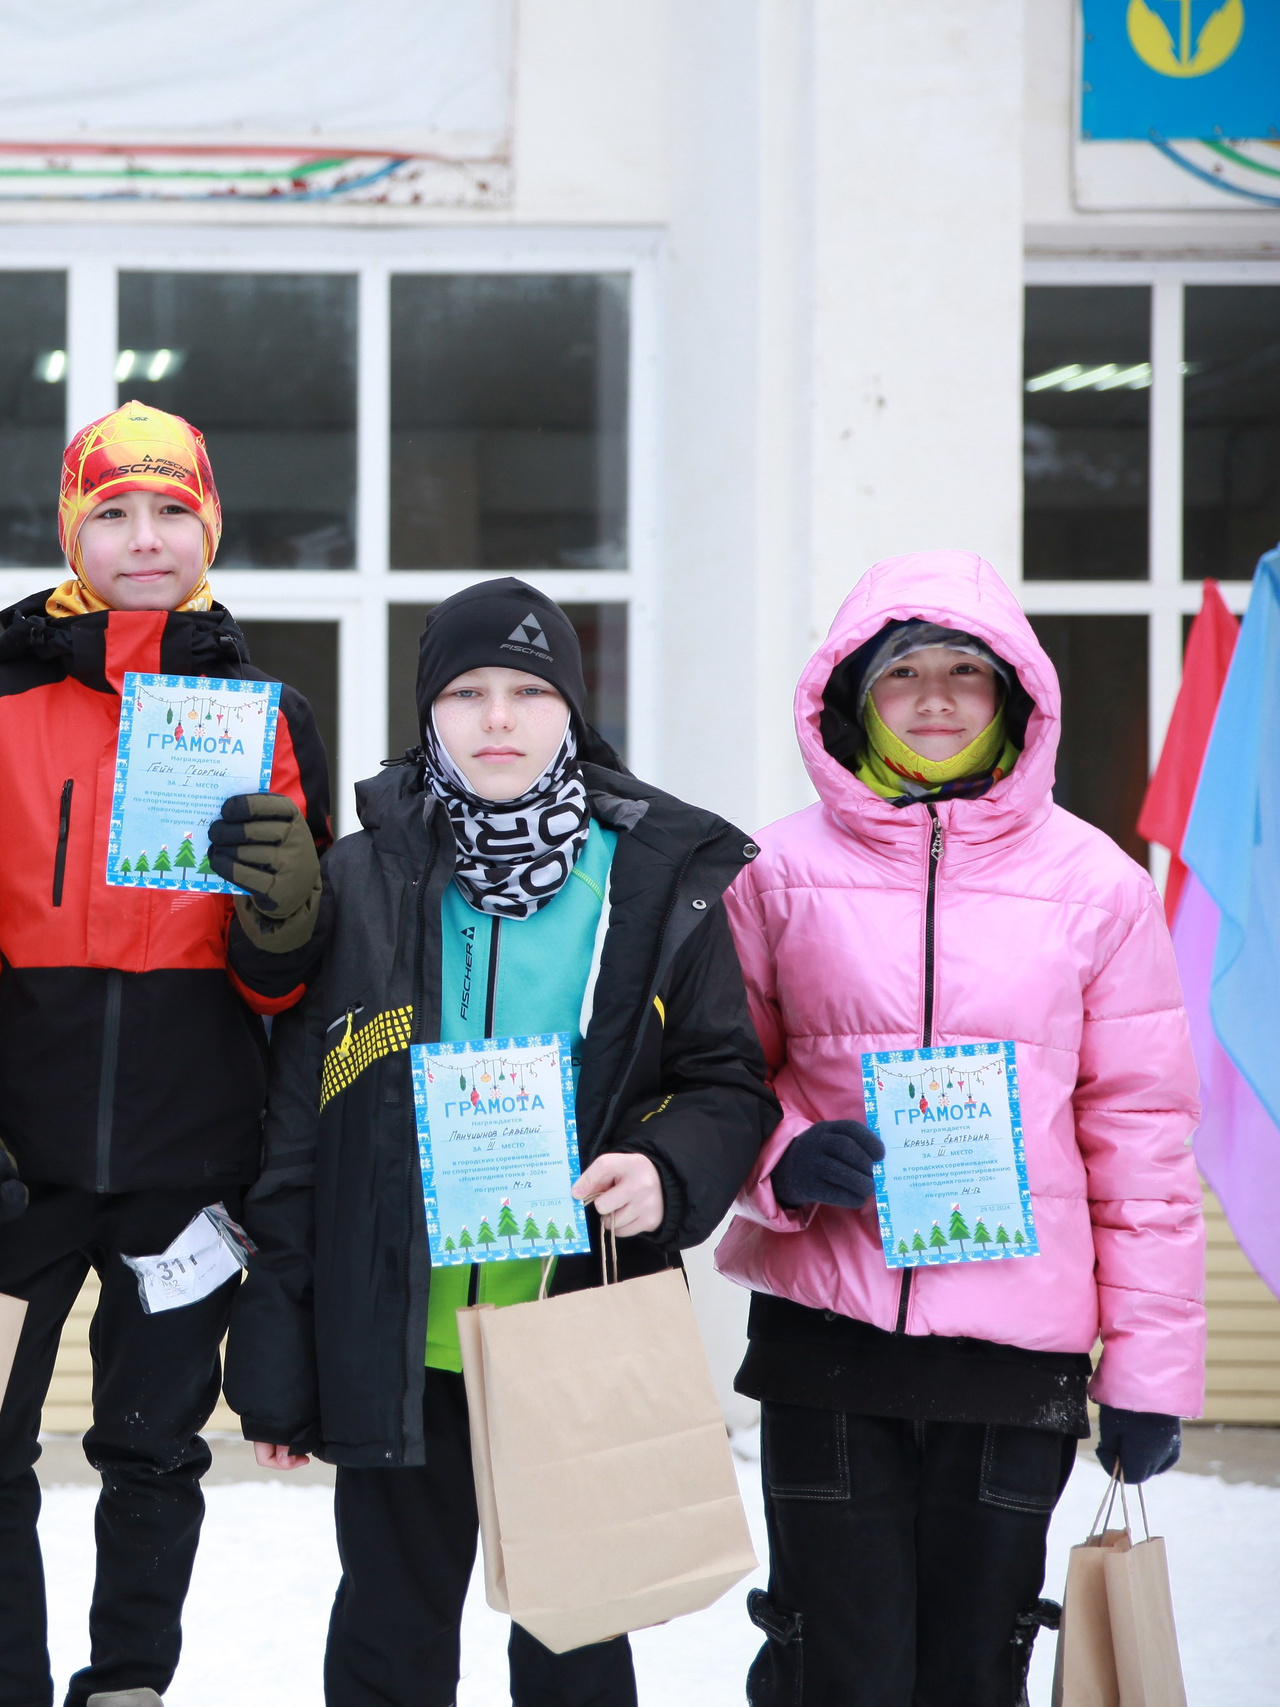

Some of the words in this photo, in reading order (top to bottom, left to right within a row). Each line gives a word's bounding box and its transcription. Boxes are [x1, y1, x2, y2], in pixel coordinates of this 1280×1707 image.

[98, 464, 186, 483] FISCHER
[500, 643, 554, 663] FISCHER
[146, 733, 245, 754] ГРАМОТА
[197, 818, 214, 826] М-1
[460, 943, 474, 1021] FISCHER
[444, 1094, 544, 1118] ГРАМОТА
[893, 1102, 992, 1125] ГРАМОТА
[471, 1117, 522, 1127] Награждается
[920, 1125, 970, 1134] Награждается
[457, 1157, 494, 1166] городских
[495, 1152, 549, 1162] соревнованиях
[907, 1164, 944, 1172] городских
[944, 1159, 998, 1169] соревнованиях
[452, 1165, 500, 1175] спортивному
[501, 1159, 562, 1170] ориентированию
[903, 1172, 948, 1181] спортивному
[950, 1166, 1011, 1176] ориентированию
[484, 1185, 508, 1193] группе
